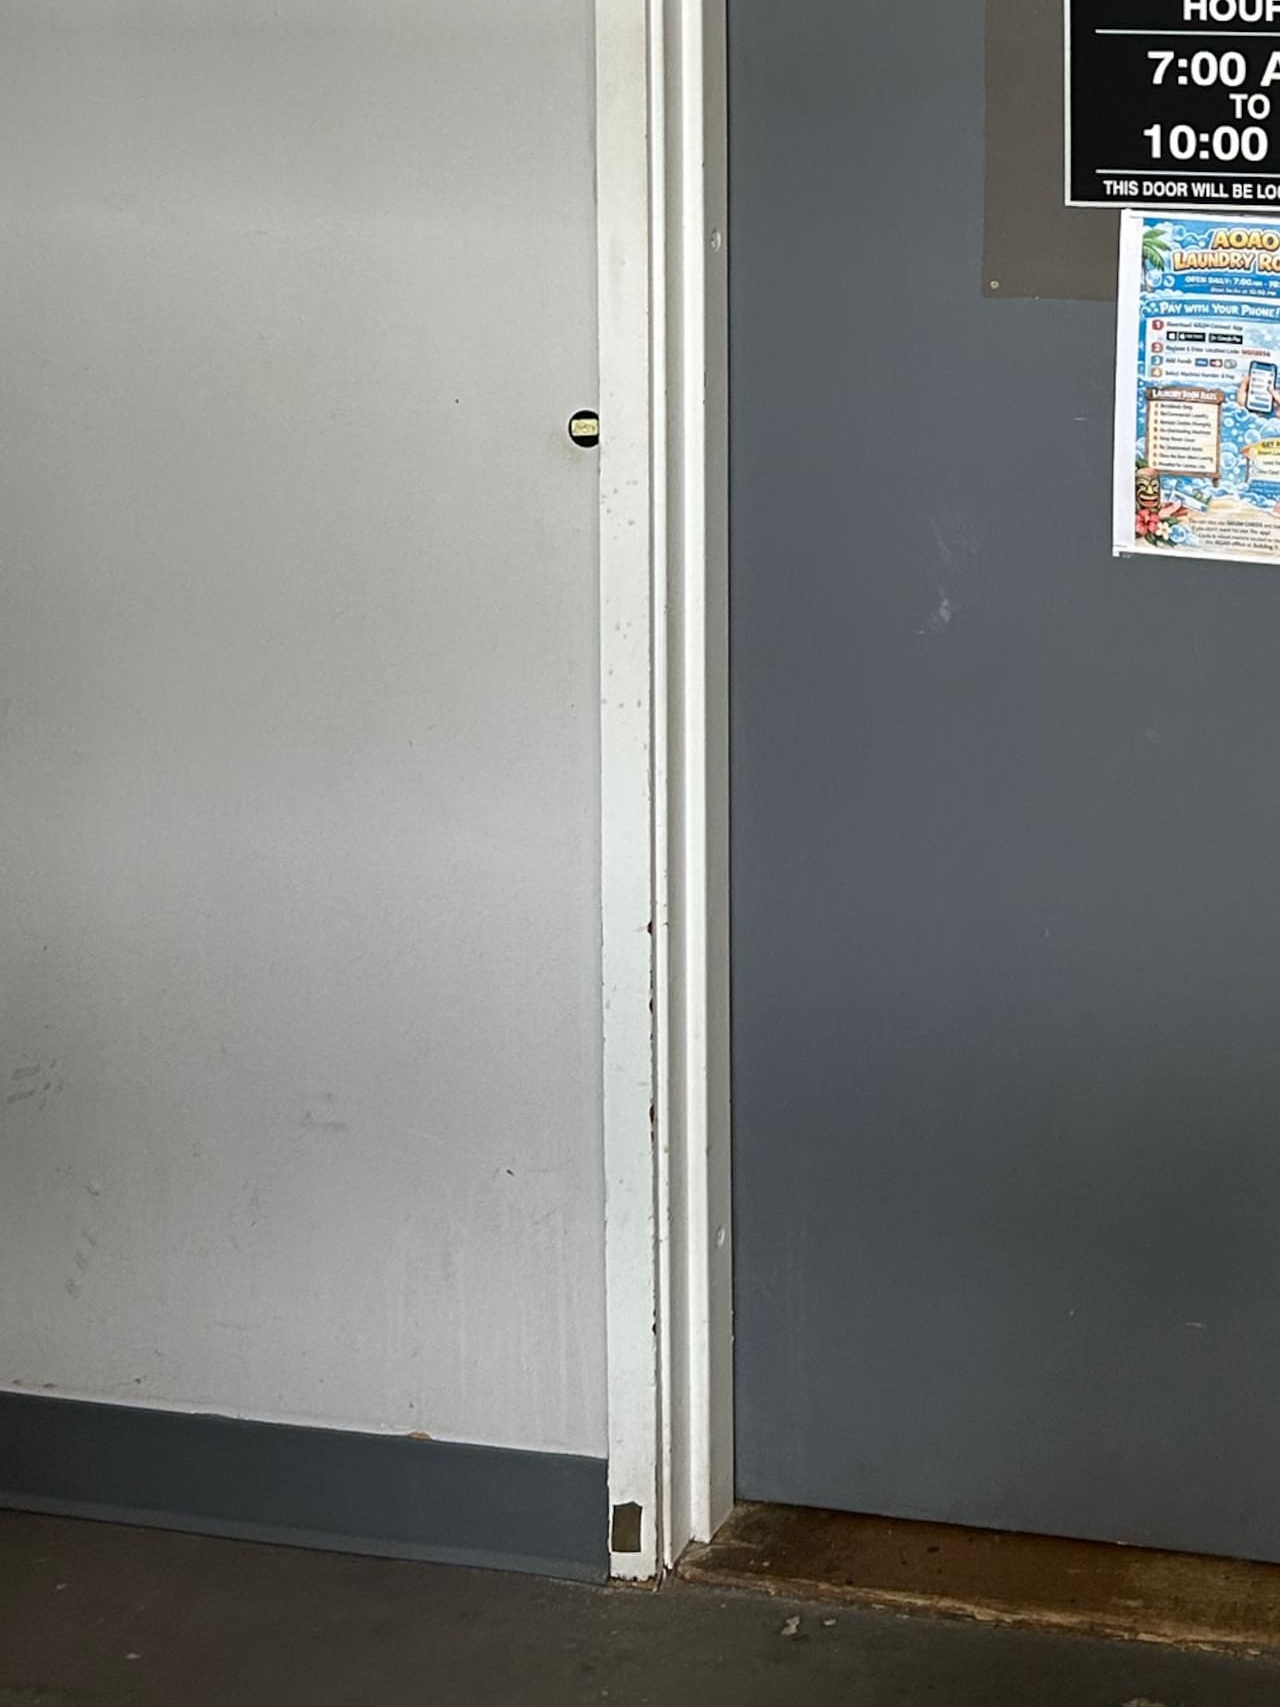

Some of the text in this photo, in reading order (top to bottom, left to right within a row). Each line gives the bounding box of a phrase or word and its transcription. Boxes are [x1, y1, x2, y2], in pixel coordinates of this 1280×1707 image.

[1147, 51, 1247, 86] 7:00
[1229, 93, 1271, 120] TO
[1143, 124, 1268, 162] 10:00
[1103, 180, 1139, 196] THIS
[1142, 181, 1188, 197] DOOR
[1191, 182, 1229, 199] WILL
[1232, 183, 1253, 199] BE
[1211, 229, 1280, 251] AOAO
[1173, 251, 1254, 271] LAUNDRY
[1160, 301, 1280, 317] PAY WITH YOUR PHONE!
